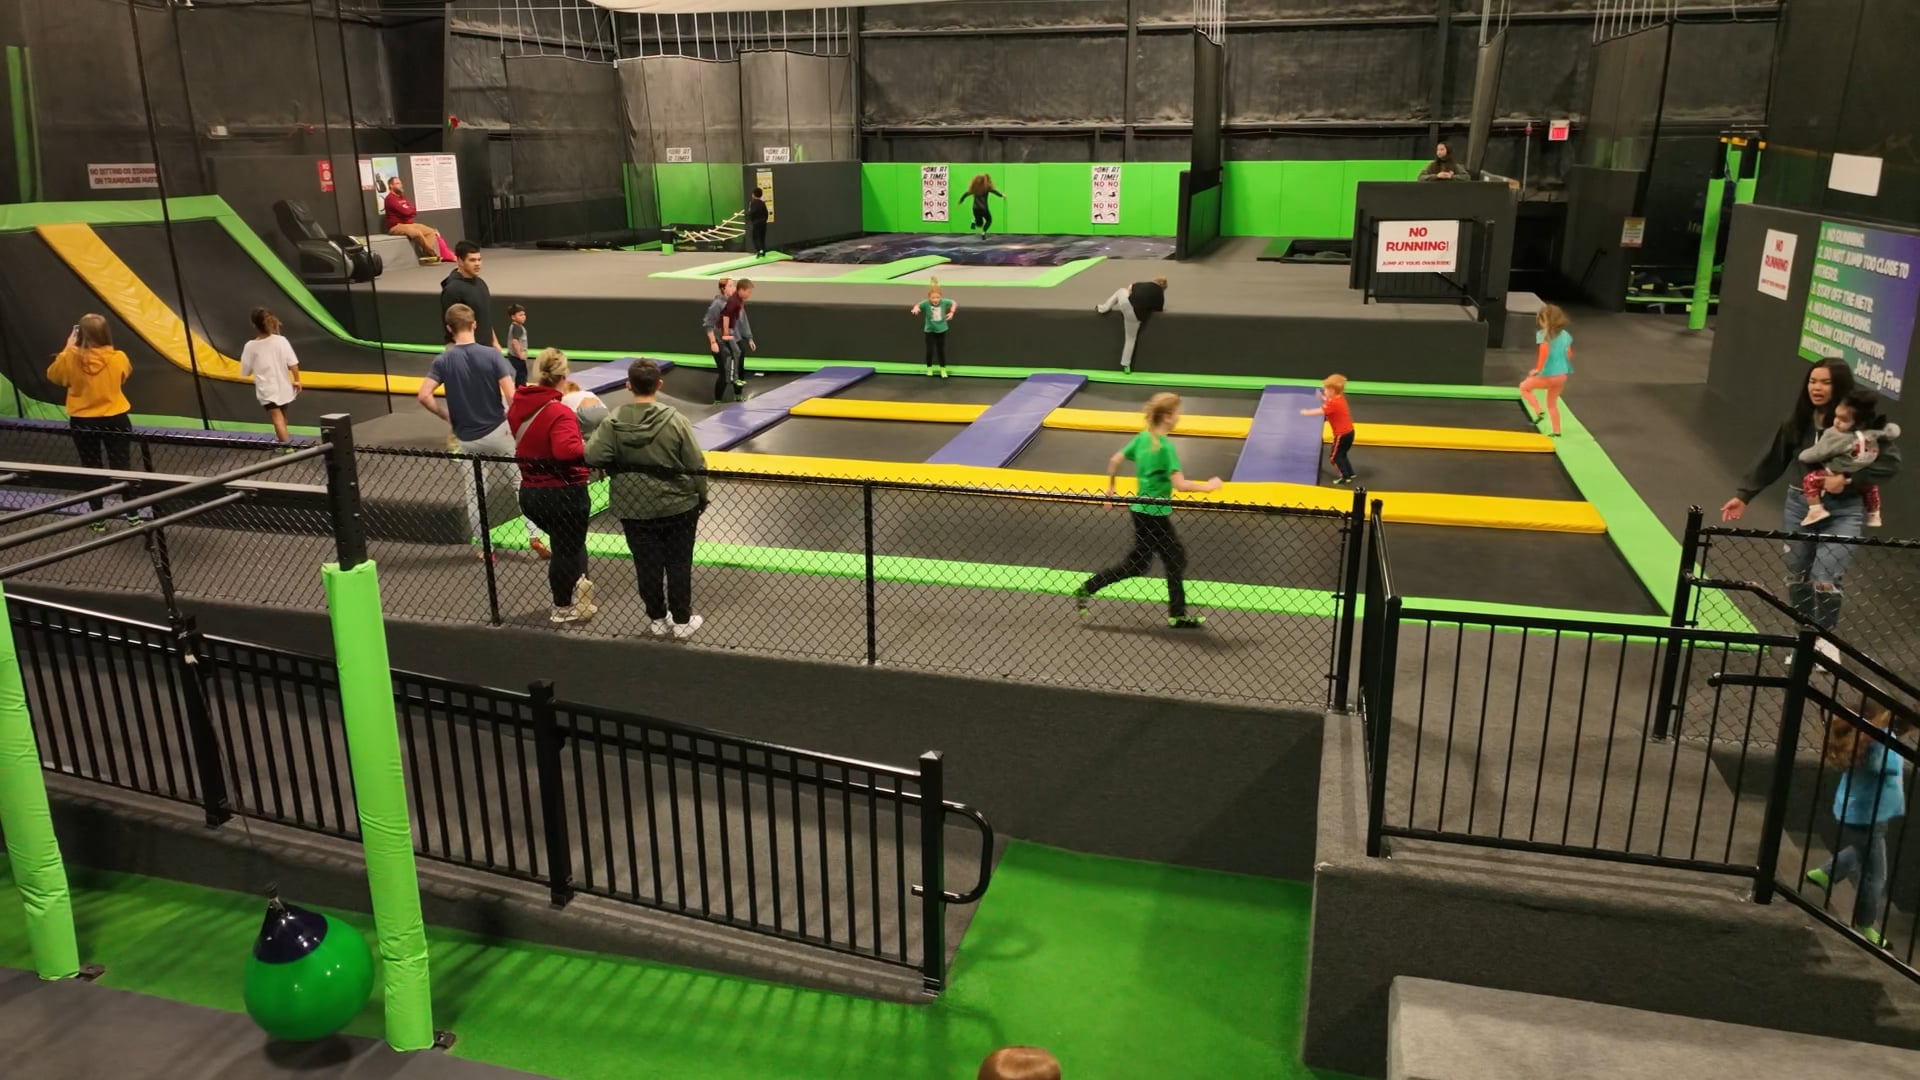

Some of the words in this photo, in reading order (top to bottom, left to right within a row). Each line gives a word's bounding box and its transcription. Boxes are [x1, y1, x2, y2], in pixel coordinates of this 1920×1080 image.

[1409, 227, 1428, 237] NO
[1386, 242, 1449, 252] RUNNING!
[1862, 253, 1876, 271] TOO
[1875, 256, 1898, 276] CLOSE
[1896, 261, 1910, 279] TO
[1830, 287, 1843, 303] OFF
[1842, 290, 1856, 307] THE
[1869, 363, 1884, 389] Big
[1883, 369, 1901, 393] Five
